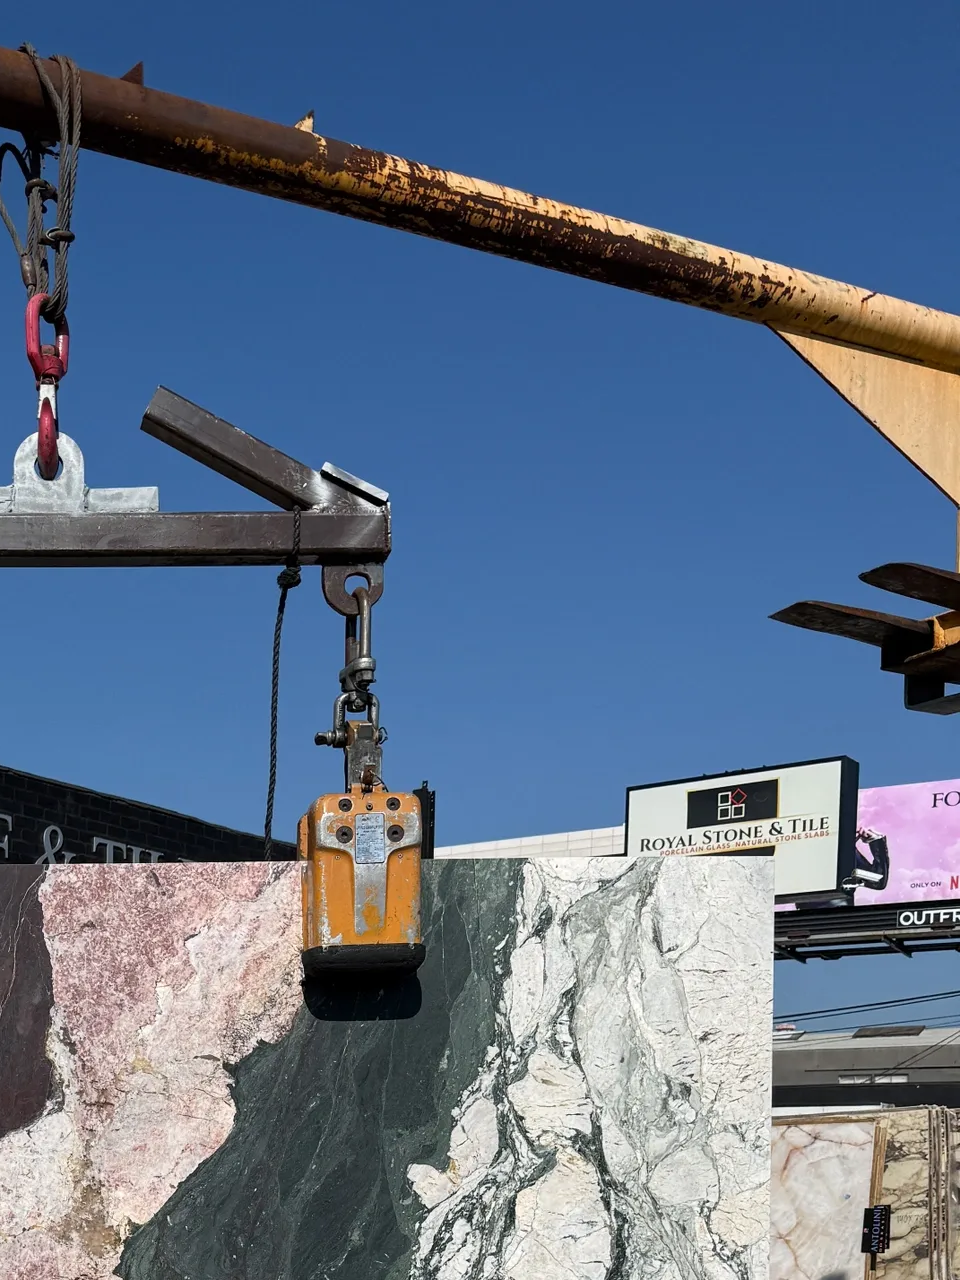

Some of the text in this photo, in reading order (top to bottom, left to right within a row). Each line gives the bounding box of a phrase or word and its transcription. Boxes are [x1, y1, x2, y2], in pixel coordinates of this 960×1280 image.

[640, 816, 830, 852] ROYAL STONE & TILE
[660, 829, 830, 856] PORCELAIN GLASS NATURAL STONE SLABS
[871, 1209, 882, 1252] ANTOLINI
